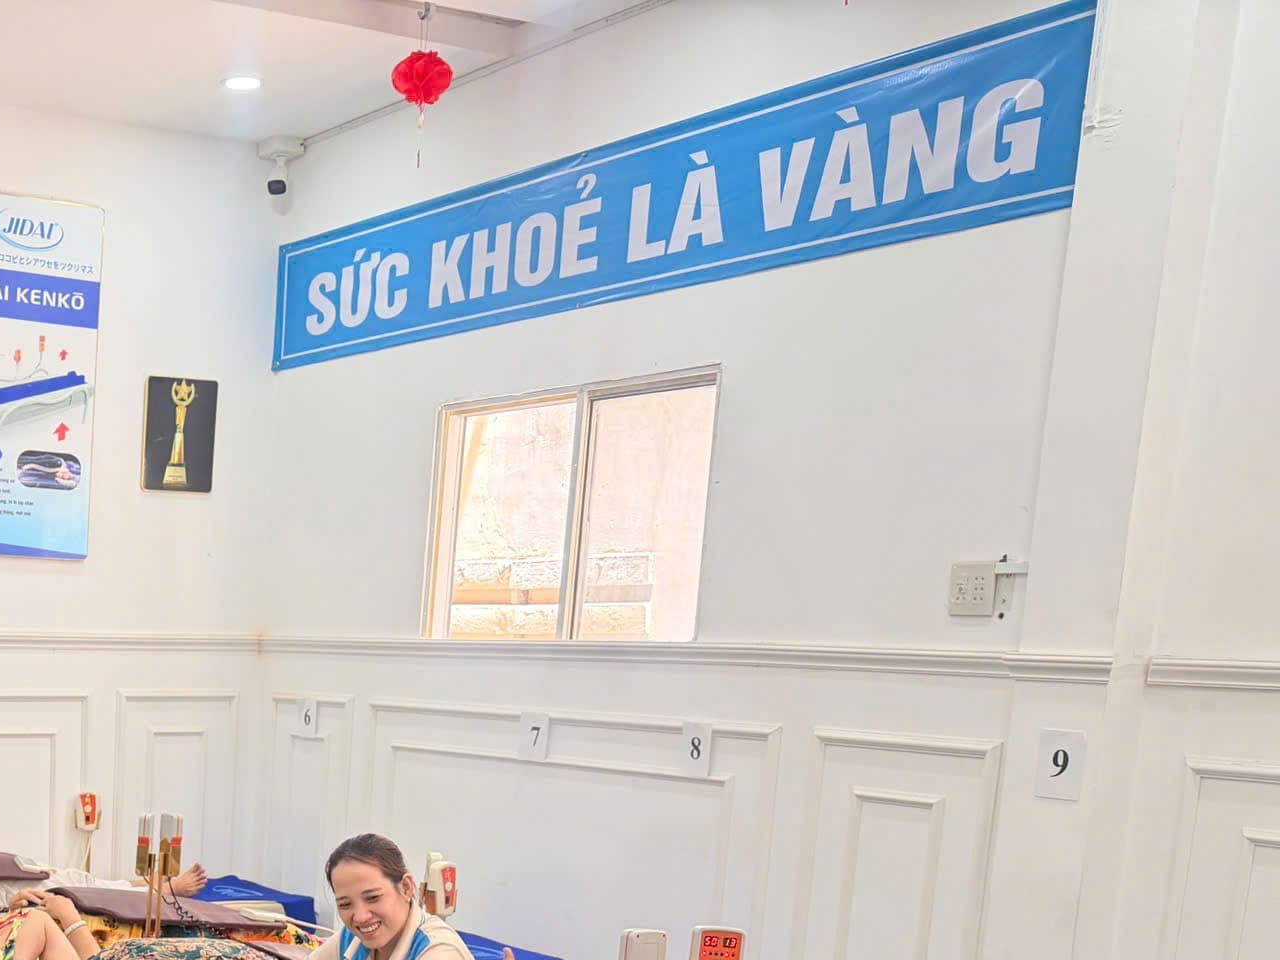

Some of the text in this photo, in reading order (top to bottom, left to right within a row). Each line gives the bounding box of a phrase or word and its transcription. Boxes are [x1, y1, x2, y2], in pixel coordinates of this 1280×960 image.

[306, 78, 1045, 336] SỨC KHOẺ LÀ VÀNG
[3, 217, 55, 240] JIDAI
[16, 287, 85, 310] KENKŌ
[304, 707, 311, 726] 6
[530, 726, 542, 747] 7
[690, 736, 701, 760] 8
[1049, 748, 1069, 778] 9
